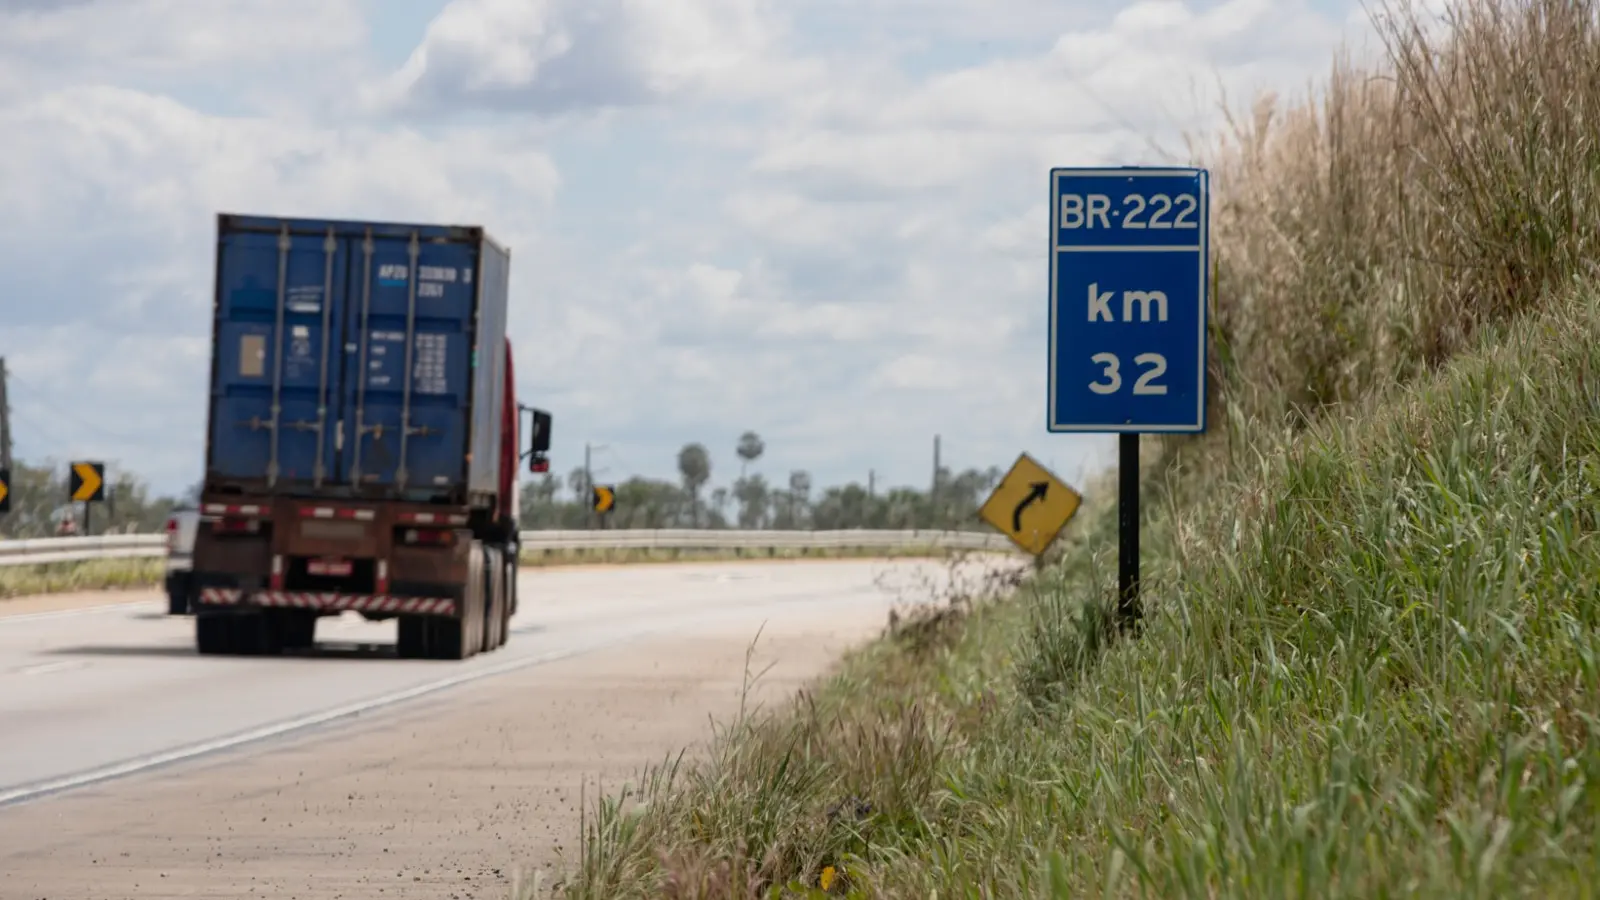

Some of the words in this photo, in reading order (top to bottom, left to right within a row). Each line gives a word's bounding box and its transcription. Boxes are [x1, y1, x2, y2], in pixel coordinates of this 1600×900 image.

[1060, 193, 1198, 229] BR-222
[1087, 282, 1169, 322] km
[1087, 352, 1168, 395] 32
